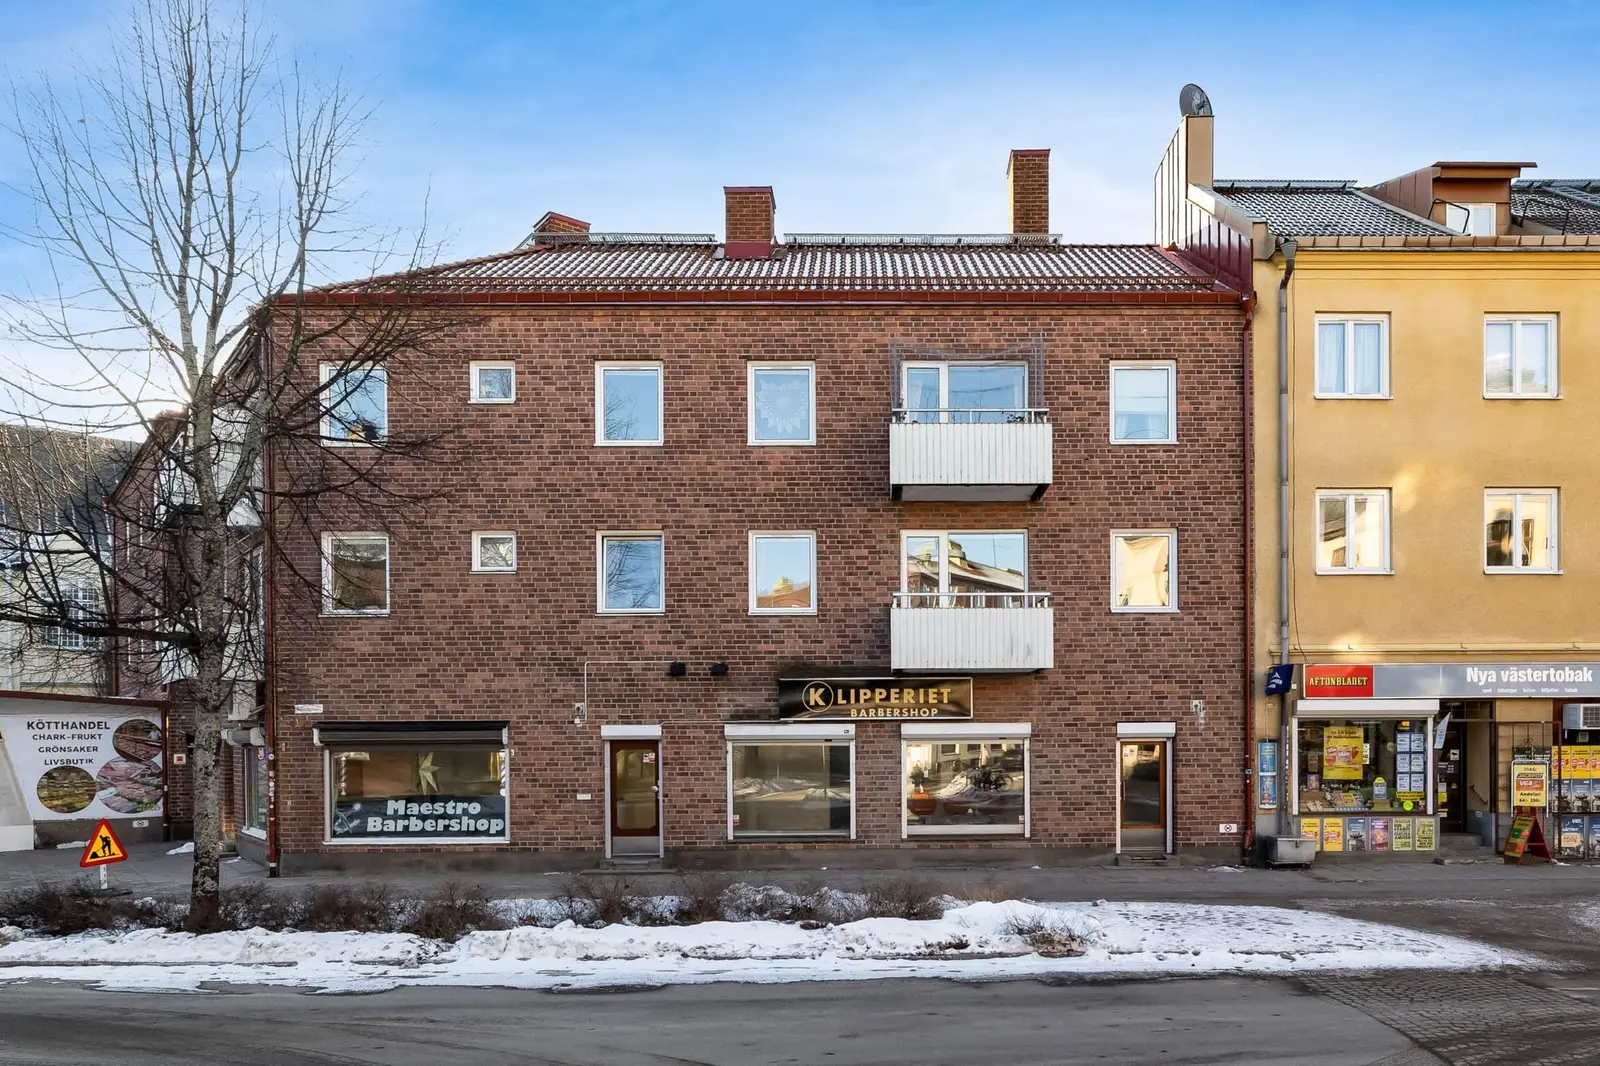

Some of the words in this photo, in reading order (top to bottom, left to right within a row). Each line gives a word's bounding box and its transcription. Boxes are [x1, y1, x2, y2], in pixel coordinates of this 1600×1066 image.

[1309, 676, 1369, 687] AFTONBLADET
[1466, 667, 1497, 686] Nya
[1500, 667, 1594, 683] västertobak
[850, 708, 939, 717] BARBERSHOP
[26, 718, 111, 730] KÖTTHANDEL
[32, 733, 103, 741] CHARK-FRUKT
[38, 744, 99, 753] GRÖNSAKER
[44, 758, 94, 766] LIVSBUTIK
[386, 799, 481, 815] Maestro
[366, 816, 504, 834] Barbershop
